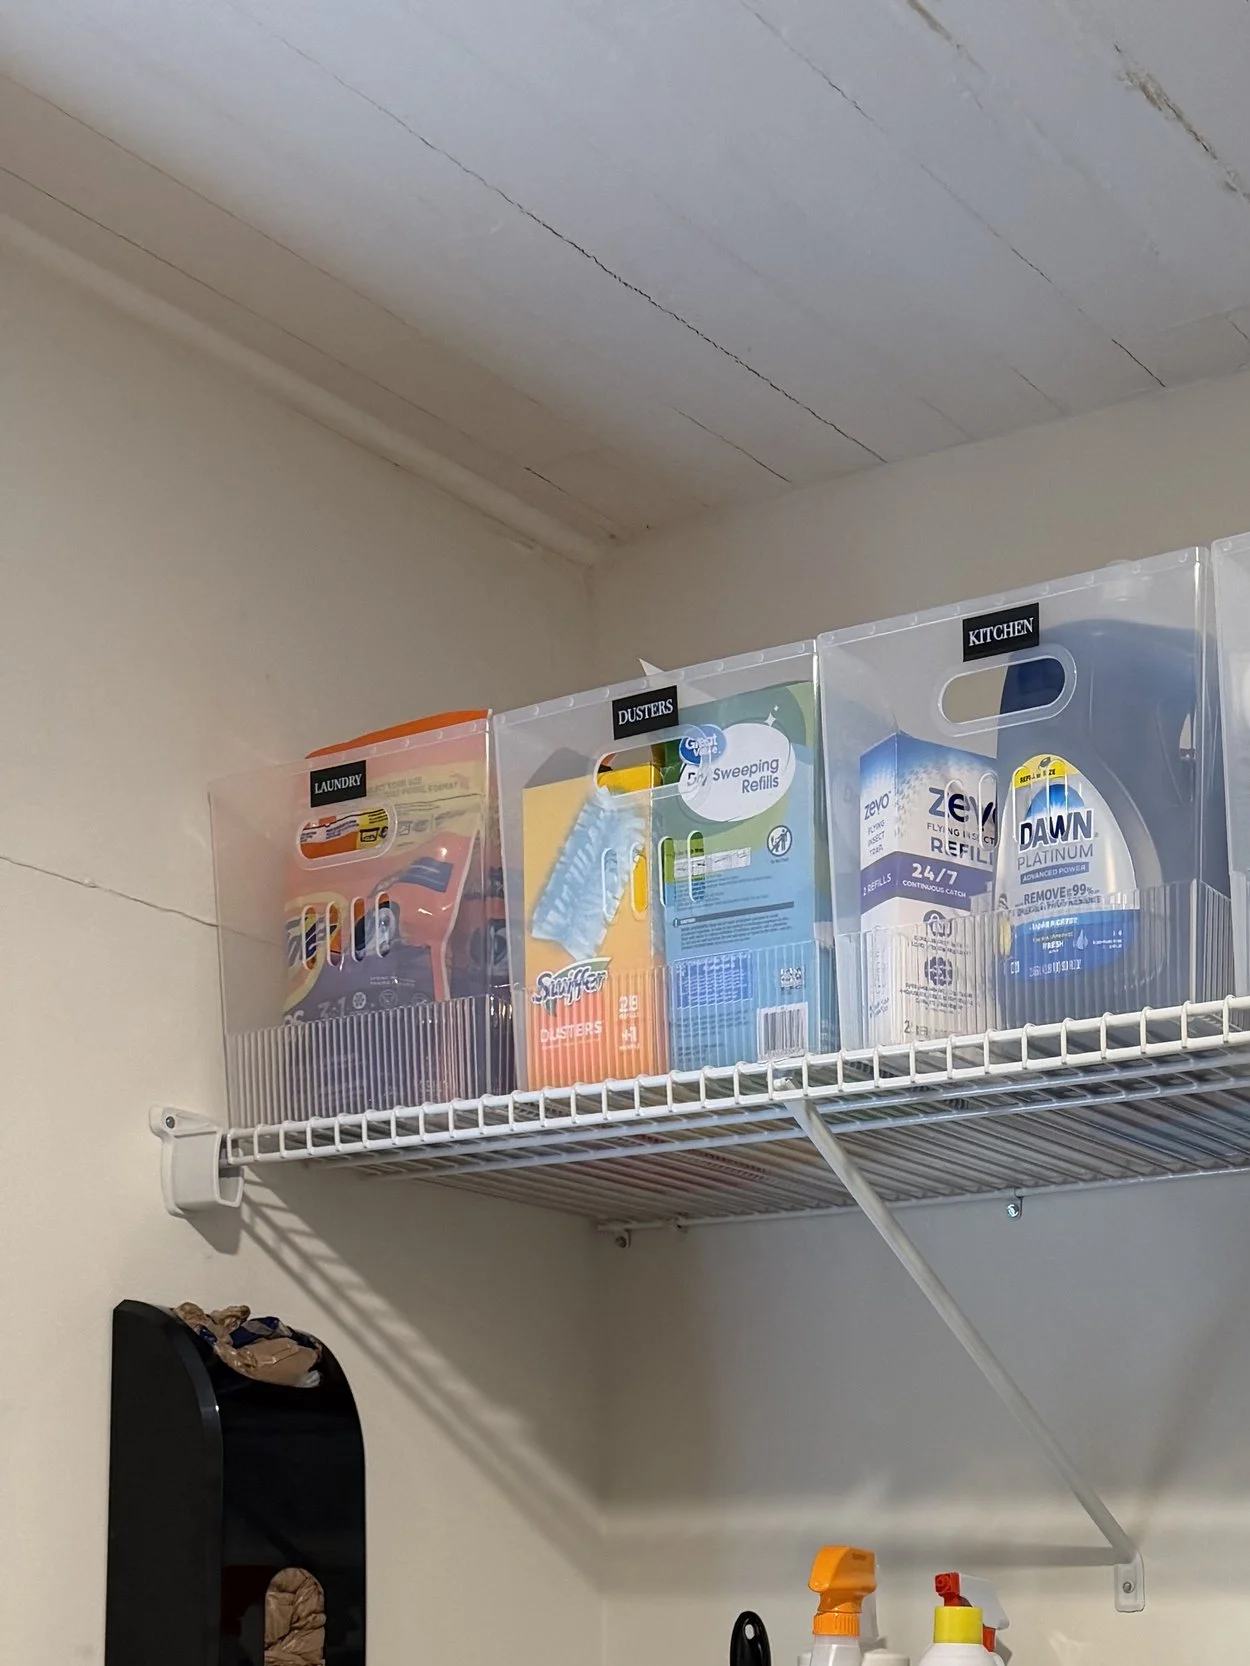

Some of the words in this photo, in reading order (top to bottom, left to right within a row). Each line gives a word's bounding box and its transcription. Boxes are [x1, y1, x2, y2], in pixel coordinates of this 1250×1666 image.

[968, 617, 1034, 647] KITCHEN
[617, 698, 674, 726] DUSTERS
[712, 757, 780, 782] Sweeping
[314, 773, 362, 795] LAUNDRY
[741, 775, 780, 794] Refills
[926, 822, 960, 837] FLYING
[1019, 809, 1093, 852] DAWN
[1017, 843, 1094, 871] PLATINUM
[867, 872, 892, 893] REFILLS
[911, 862, 958, 885] 24/7
[902, 879, 945, 894] CONTINUOUS
[945, 887, 967, 898] CATCH
[1024, 886, 1066, 906] REMOVE
[532, 966, 607, 1006] Swiffer
[540, 1020, 603, 1043] DUSTERS
